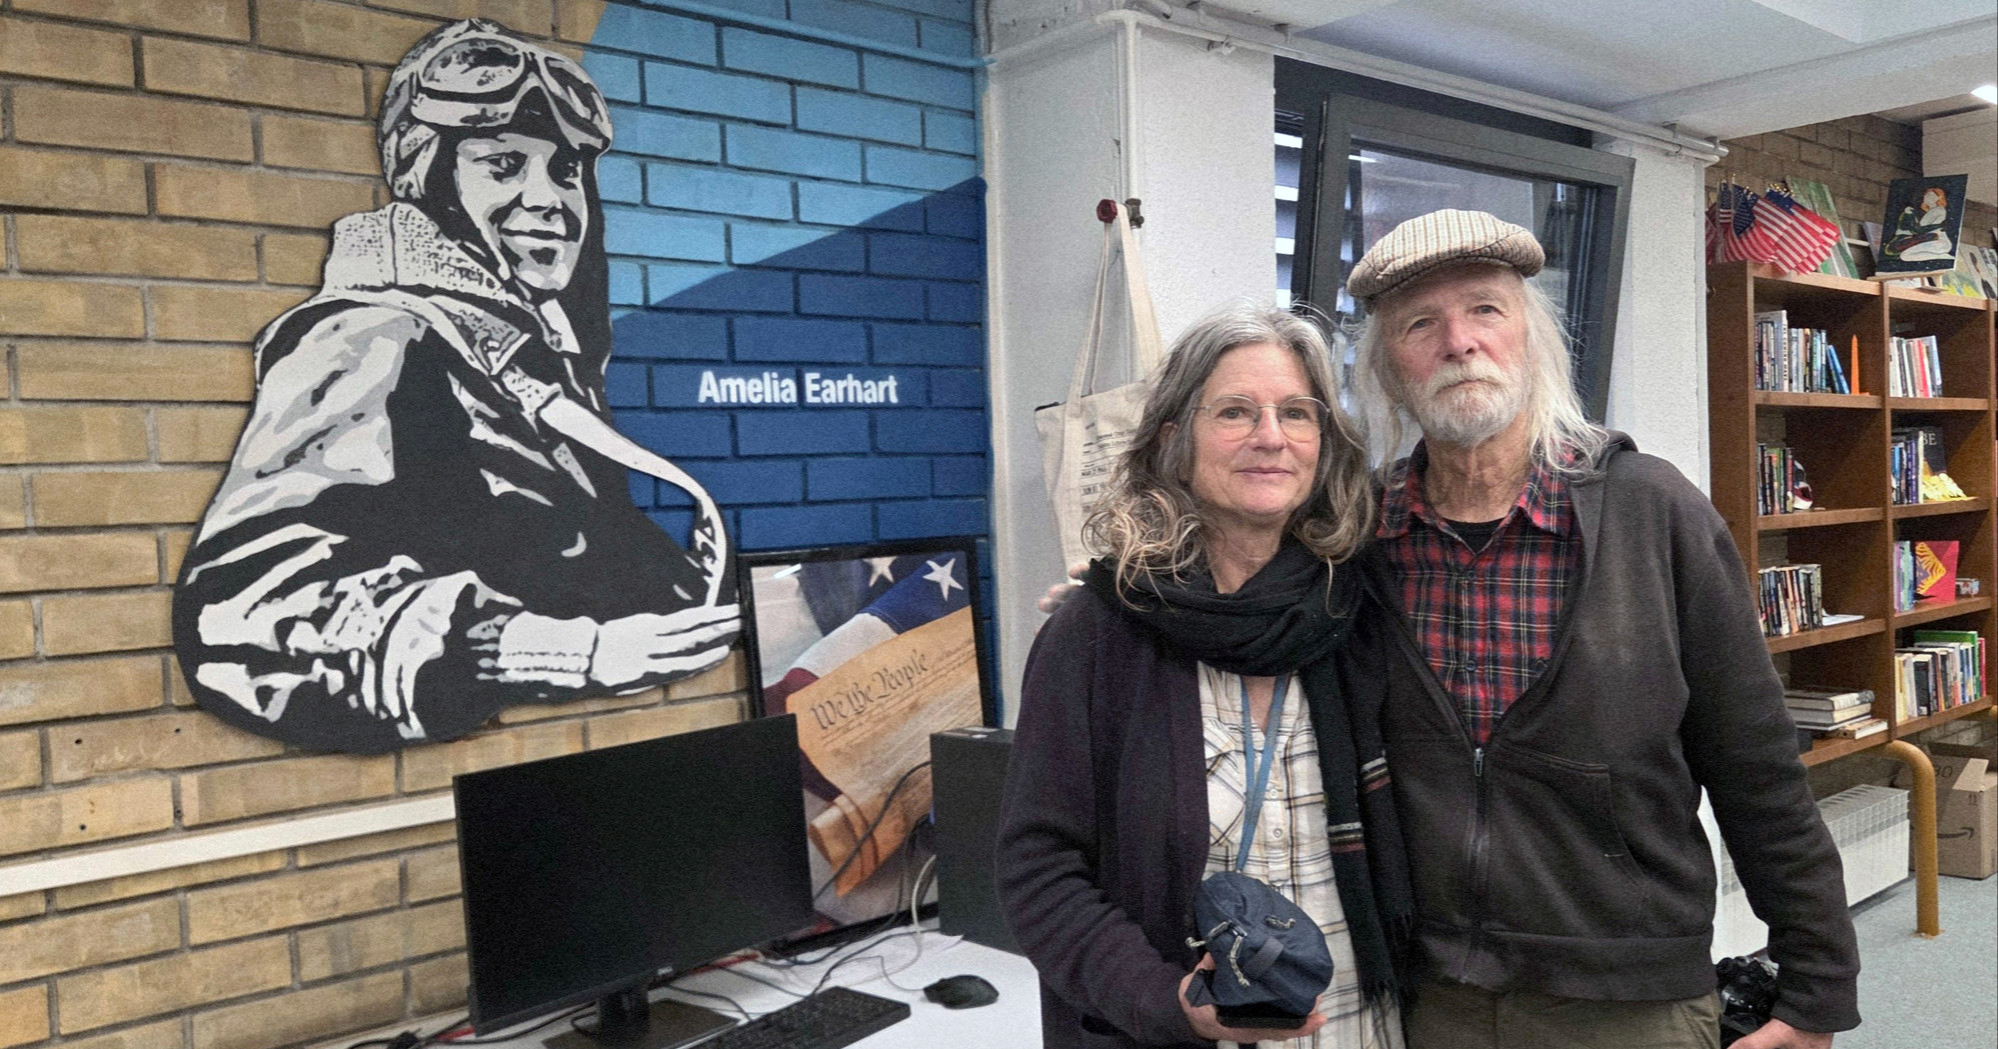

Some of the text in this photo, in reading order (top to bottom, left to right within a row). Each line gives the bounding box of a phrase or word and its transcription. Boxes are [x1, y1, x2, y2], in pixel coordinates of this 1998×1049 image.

[698, 371, 898, 403] Amelia Earhart
[811, 700, 848, 729] We
[839, 682, 874, 715] the
[872, 649, 928, 699] People
